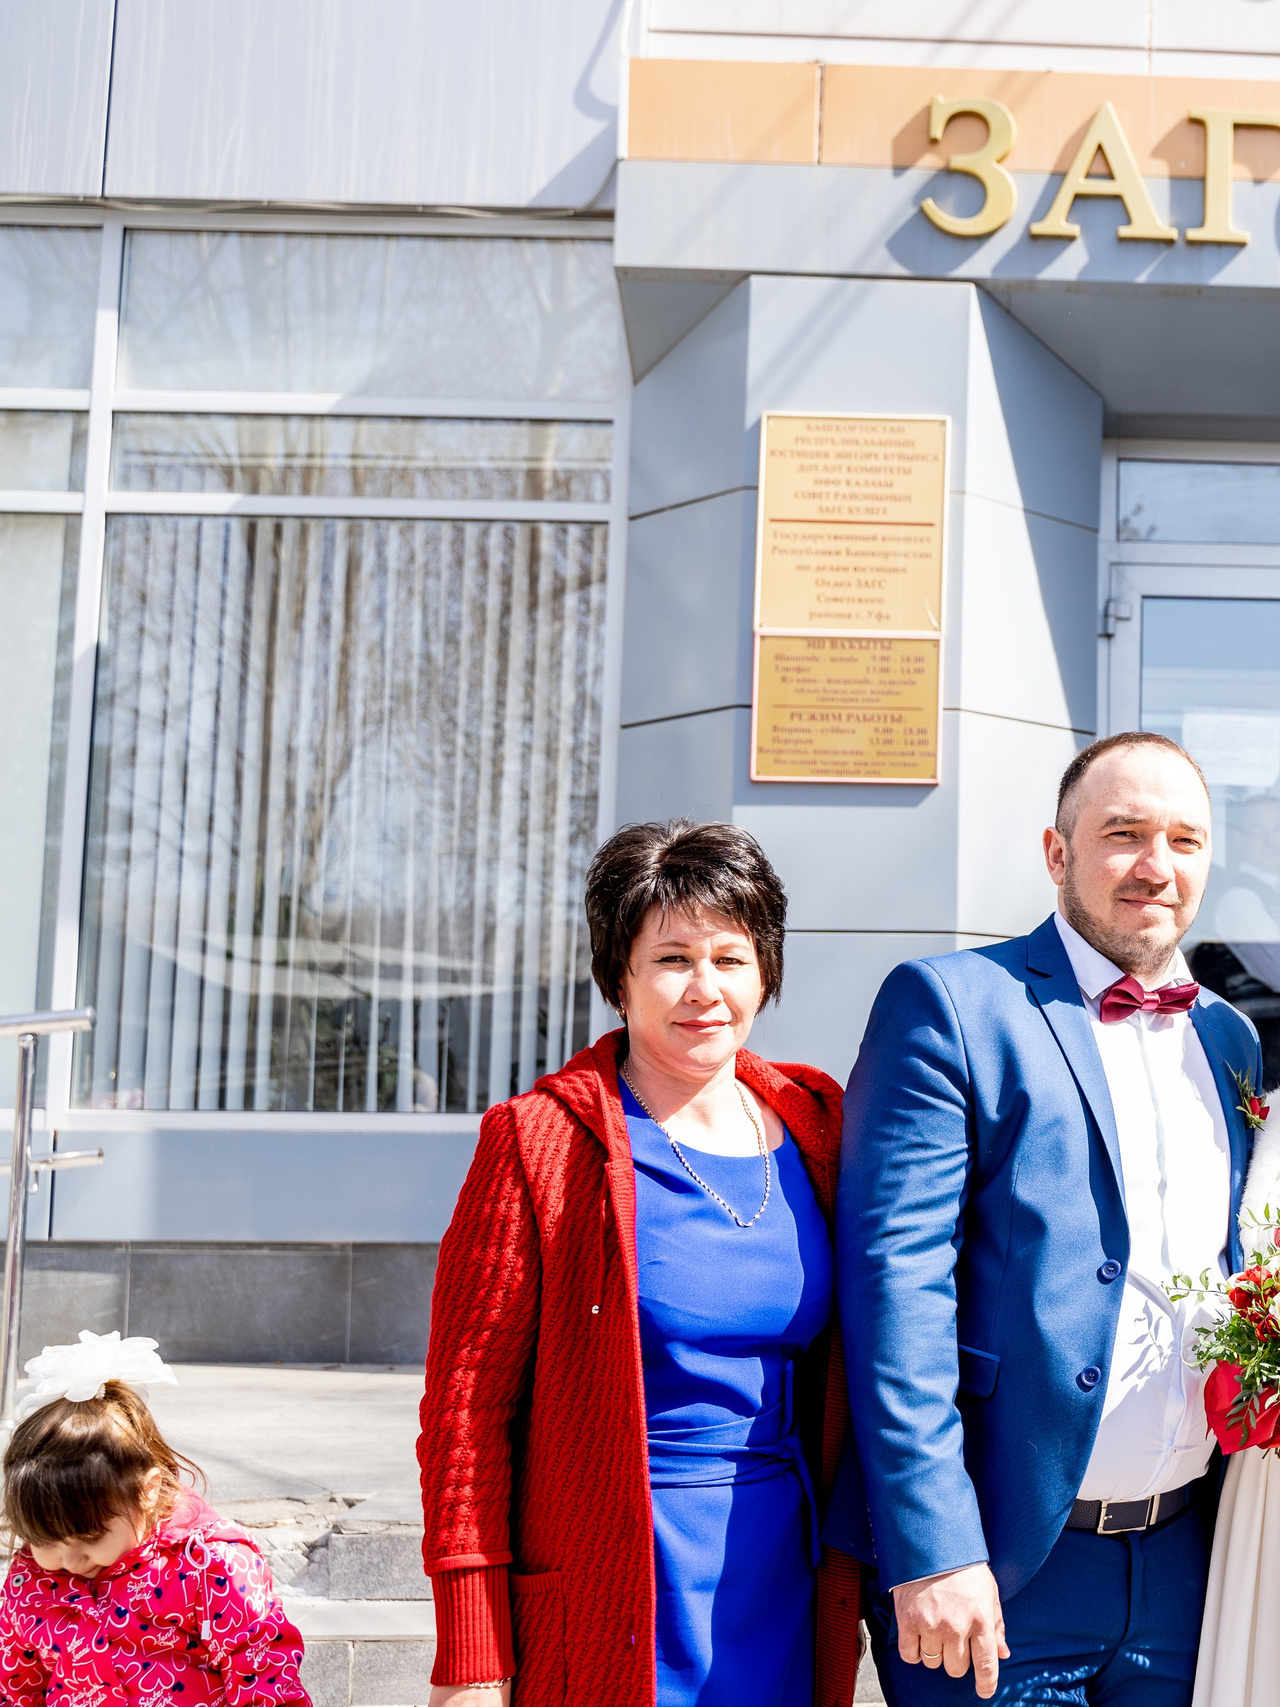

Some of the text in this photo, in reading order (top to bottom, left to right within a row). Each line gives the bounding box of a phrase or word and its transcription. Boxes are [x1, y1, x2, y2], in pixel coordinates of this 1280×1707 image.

[772, 530, 879, 544] Государственный
[771, 546, 932, 561] Республики Башкортостан
[815, 578, 887, 589] Отдел ЗАГС
[816, 594, 885, 604] Советского
[808, 610, 852, 621] района
[789, 711, 908, 724] РЕЖИМ РАБОТЫ:
